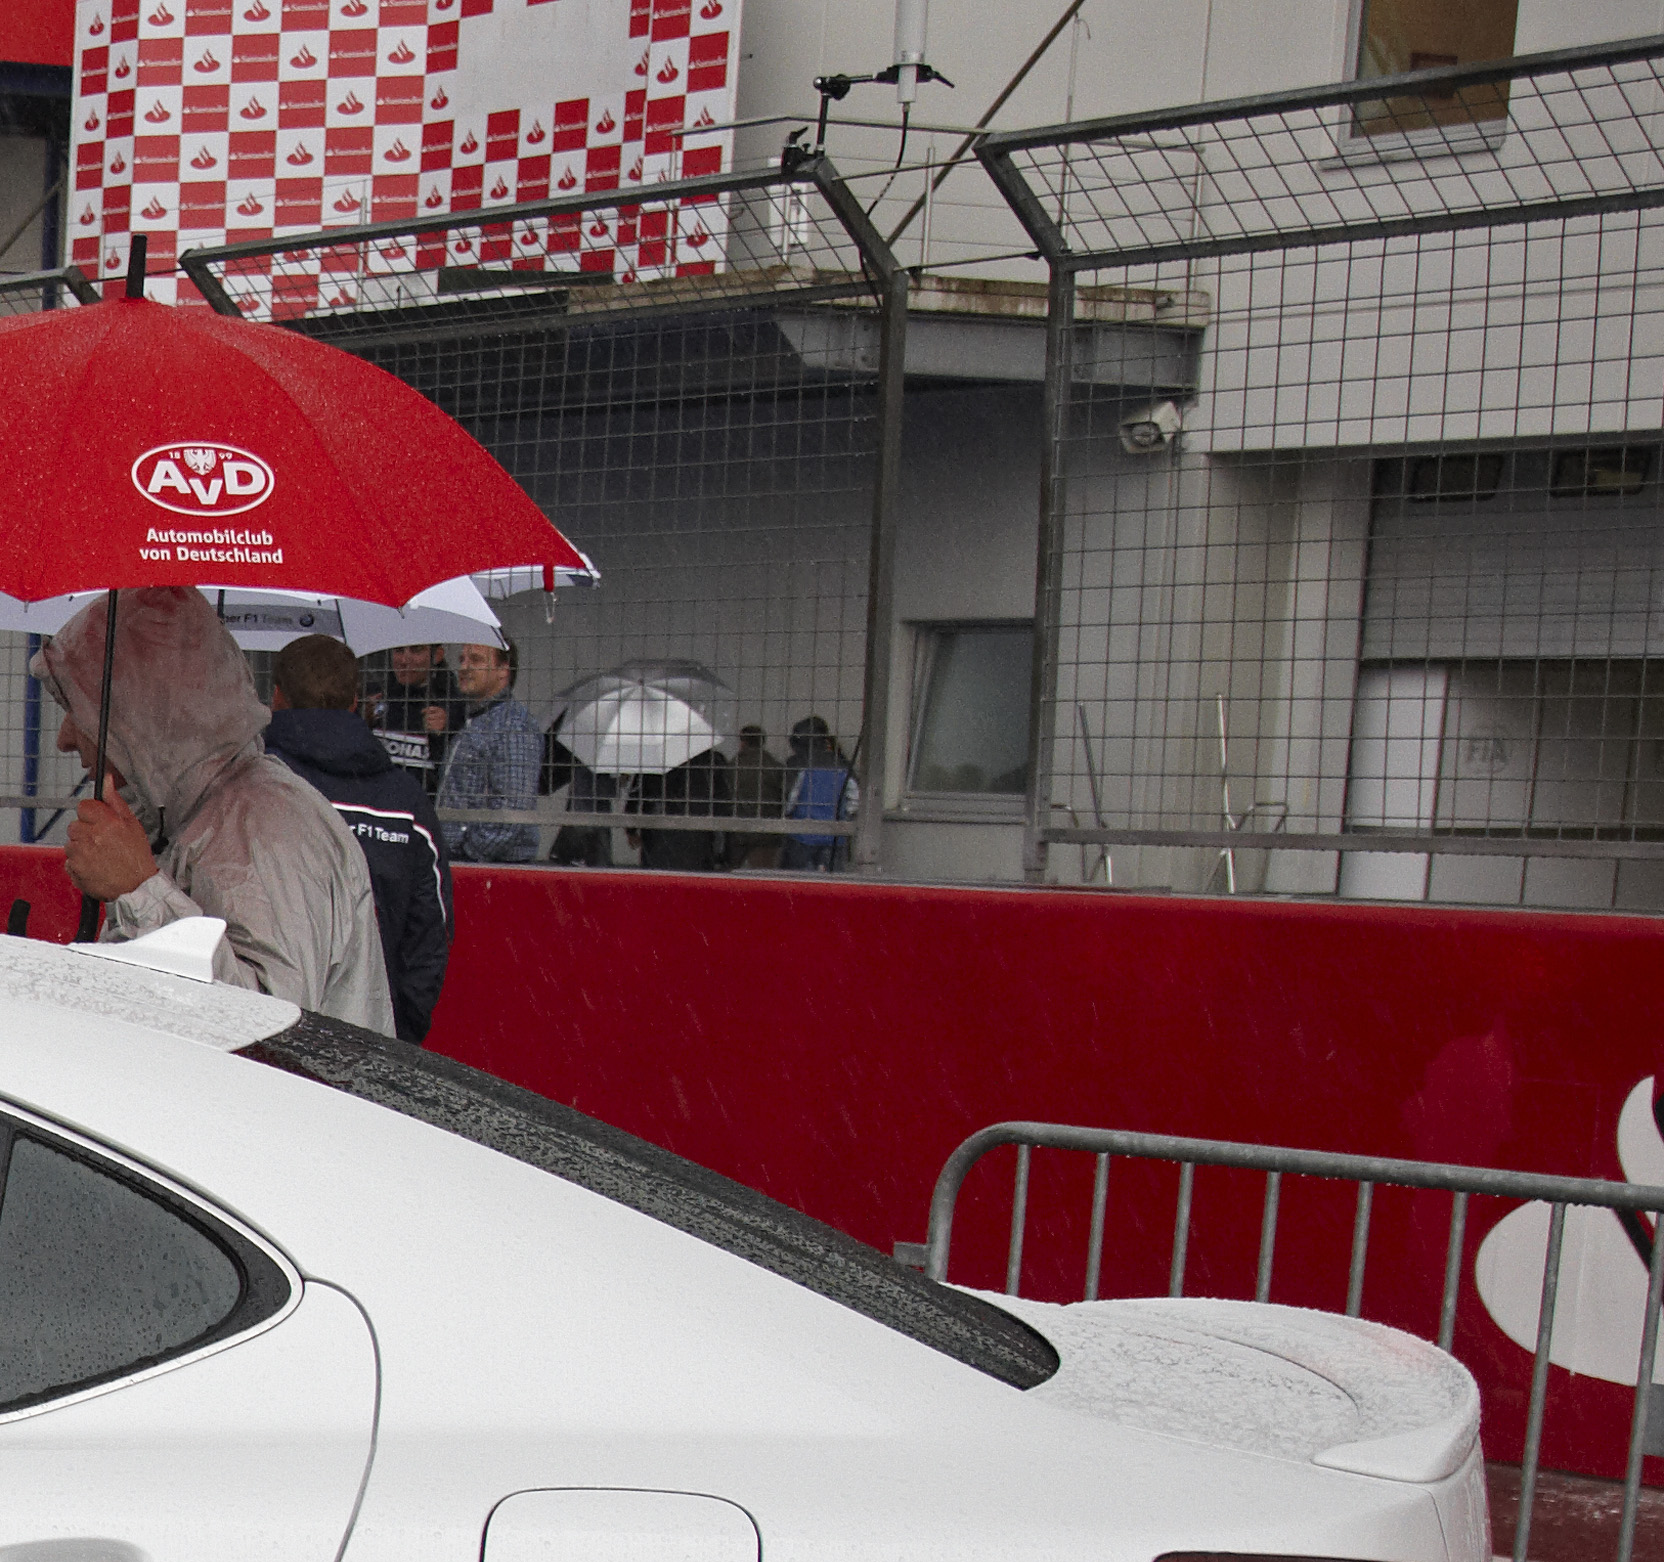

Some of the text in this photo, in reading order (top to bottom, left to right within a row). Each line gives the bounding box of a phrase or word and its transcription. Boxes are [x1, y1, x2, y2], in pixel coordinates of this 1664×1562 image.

[147, 528, 273, 545] Automobilclub
[139, 546, 283, 564] von Deutschland
[357, 822, 373, 838] F1
[374, 826, 410, 844] Team
